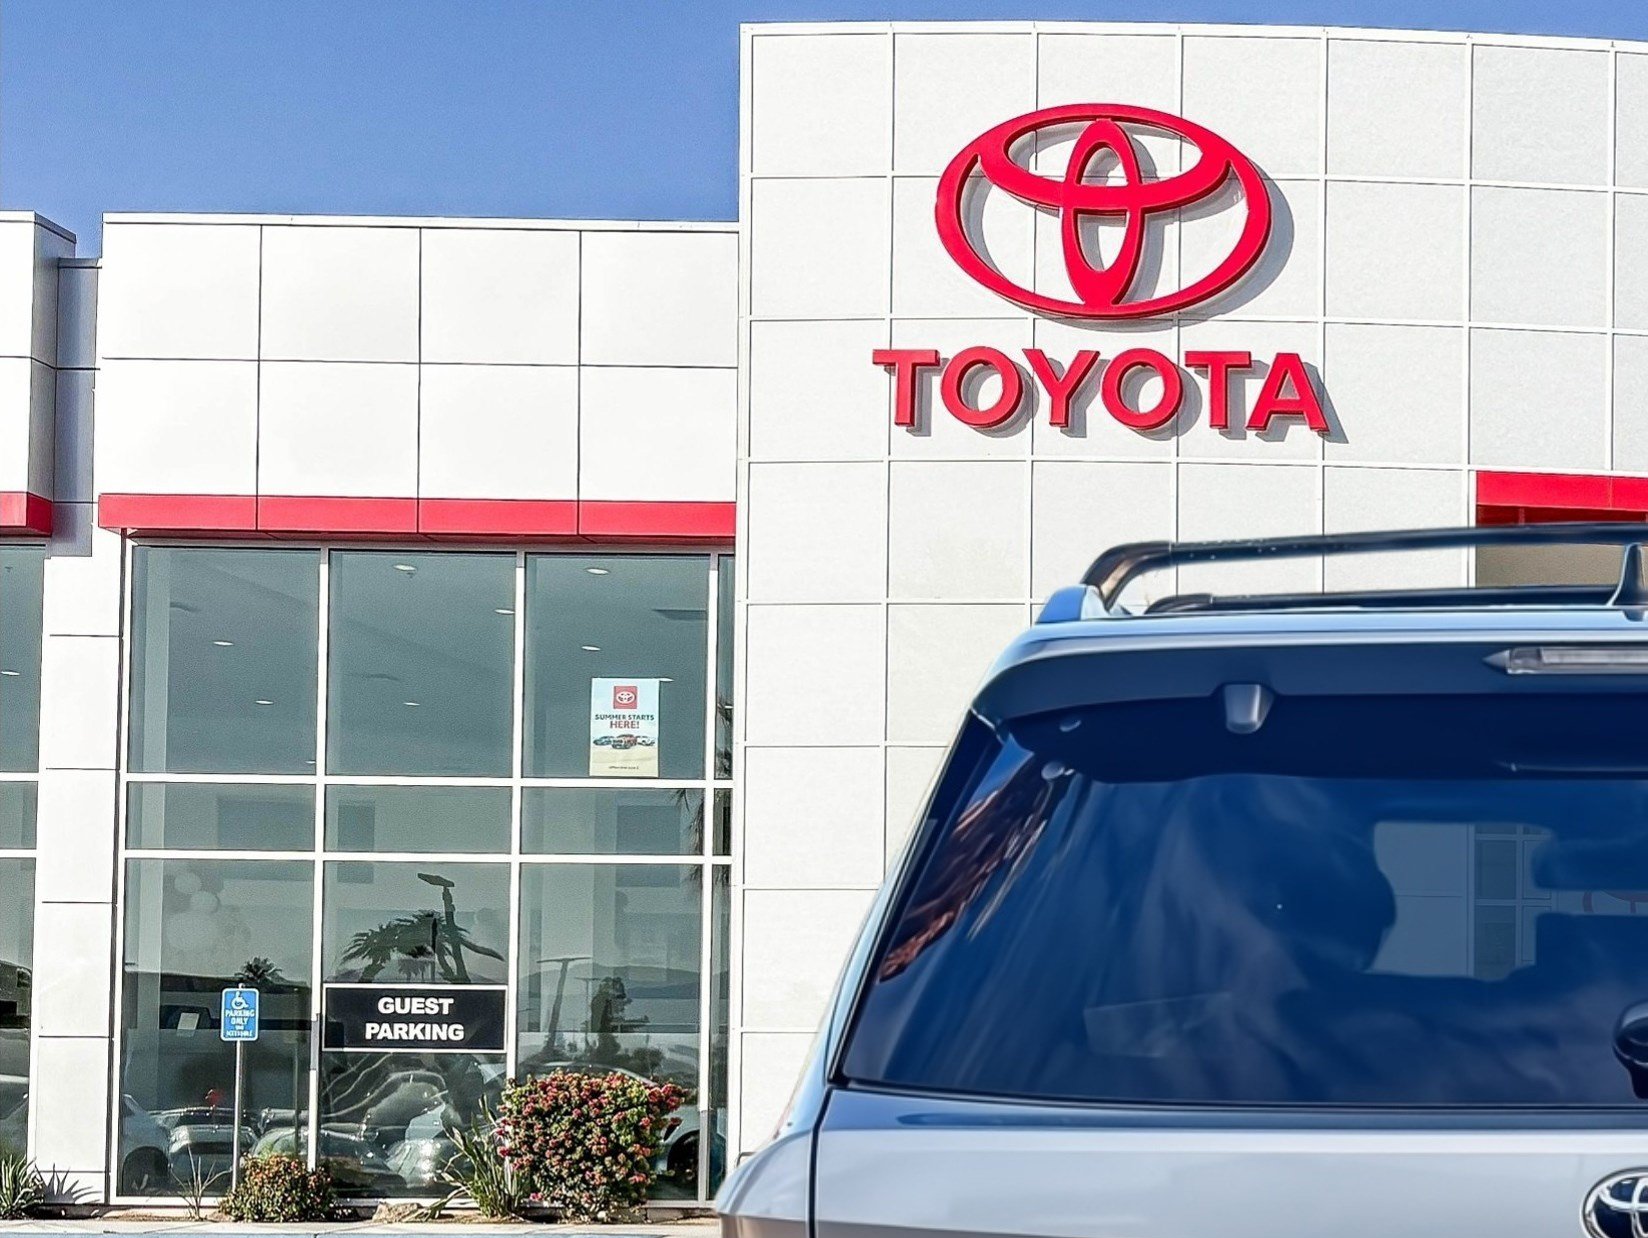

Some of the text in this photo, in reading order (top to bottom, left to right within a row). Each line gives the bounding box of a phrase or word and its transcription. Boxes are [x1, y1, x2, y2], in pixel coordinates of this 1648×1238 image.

[873, 346, 1330, 432] TOYOTA
[609, 720, 640, 728] HERE!
[377, 997, 454, 1014] GUEST
[231, 1017, 249, 1025] ONLY
[365, 1023, 464, 1041] PARKING
